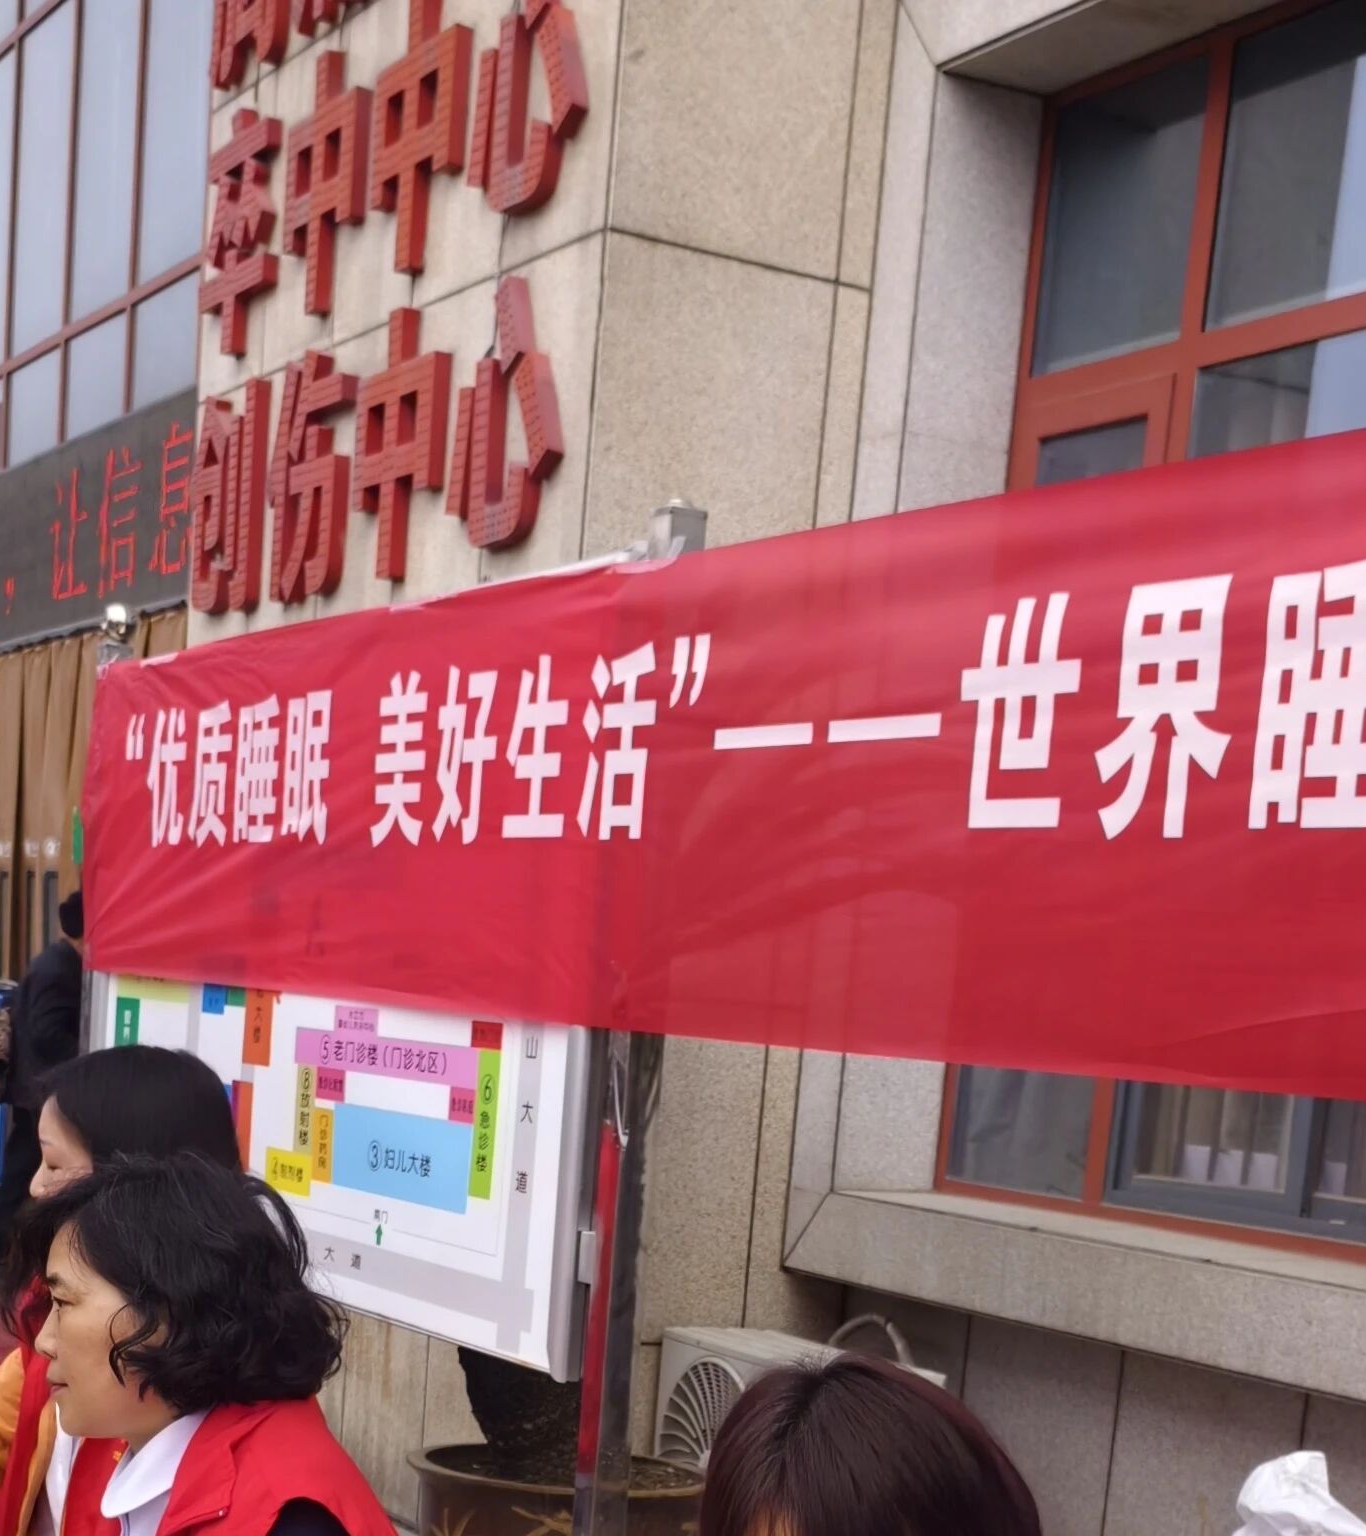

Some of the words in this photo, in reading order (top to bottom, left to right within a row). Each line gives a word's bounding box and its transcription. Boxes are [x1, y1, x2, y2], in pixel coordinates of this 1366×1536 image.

[199, 0, 589, 357] 卒中中心
[192, 276, 564, 615] 创伤中心
[125, 689, 332, 848] “优质睡眠
